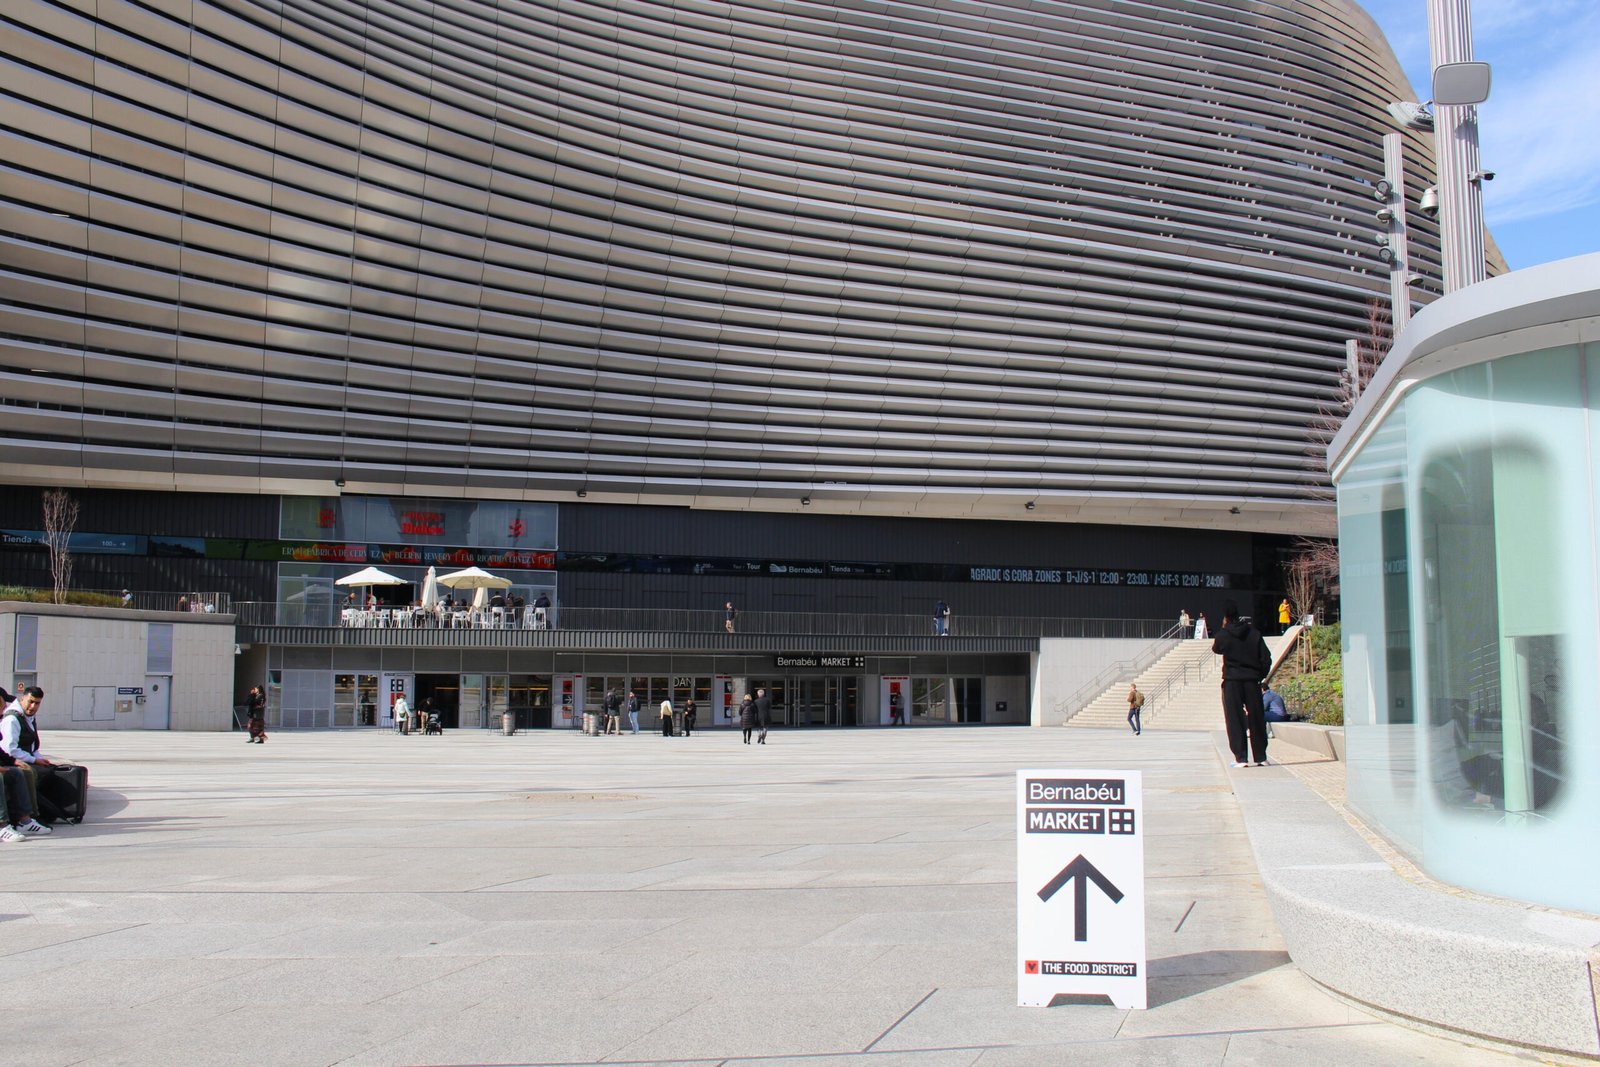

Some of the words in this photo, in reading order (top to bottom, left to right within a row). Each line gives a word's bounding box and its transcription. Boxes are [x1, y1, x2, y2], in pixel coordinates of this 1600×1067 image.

[2, 534, 32, 543] Tienda
[746, 562, 761, 570] Tour
[831, 565, 851, 573] Tienda
[777, 657, 817, 666] Bernabéu
[821, 657, 851, 666] MARKET
[1029, 782, 1121, 801] Bernabéu
[1030, 812, 1101, 830] MARKET
[1043, 962, 1062, 973] THE
[1064, 963, 1090, 974] FOOD
[1092, 964, 1135, 975] DISTRICT
